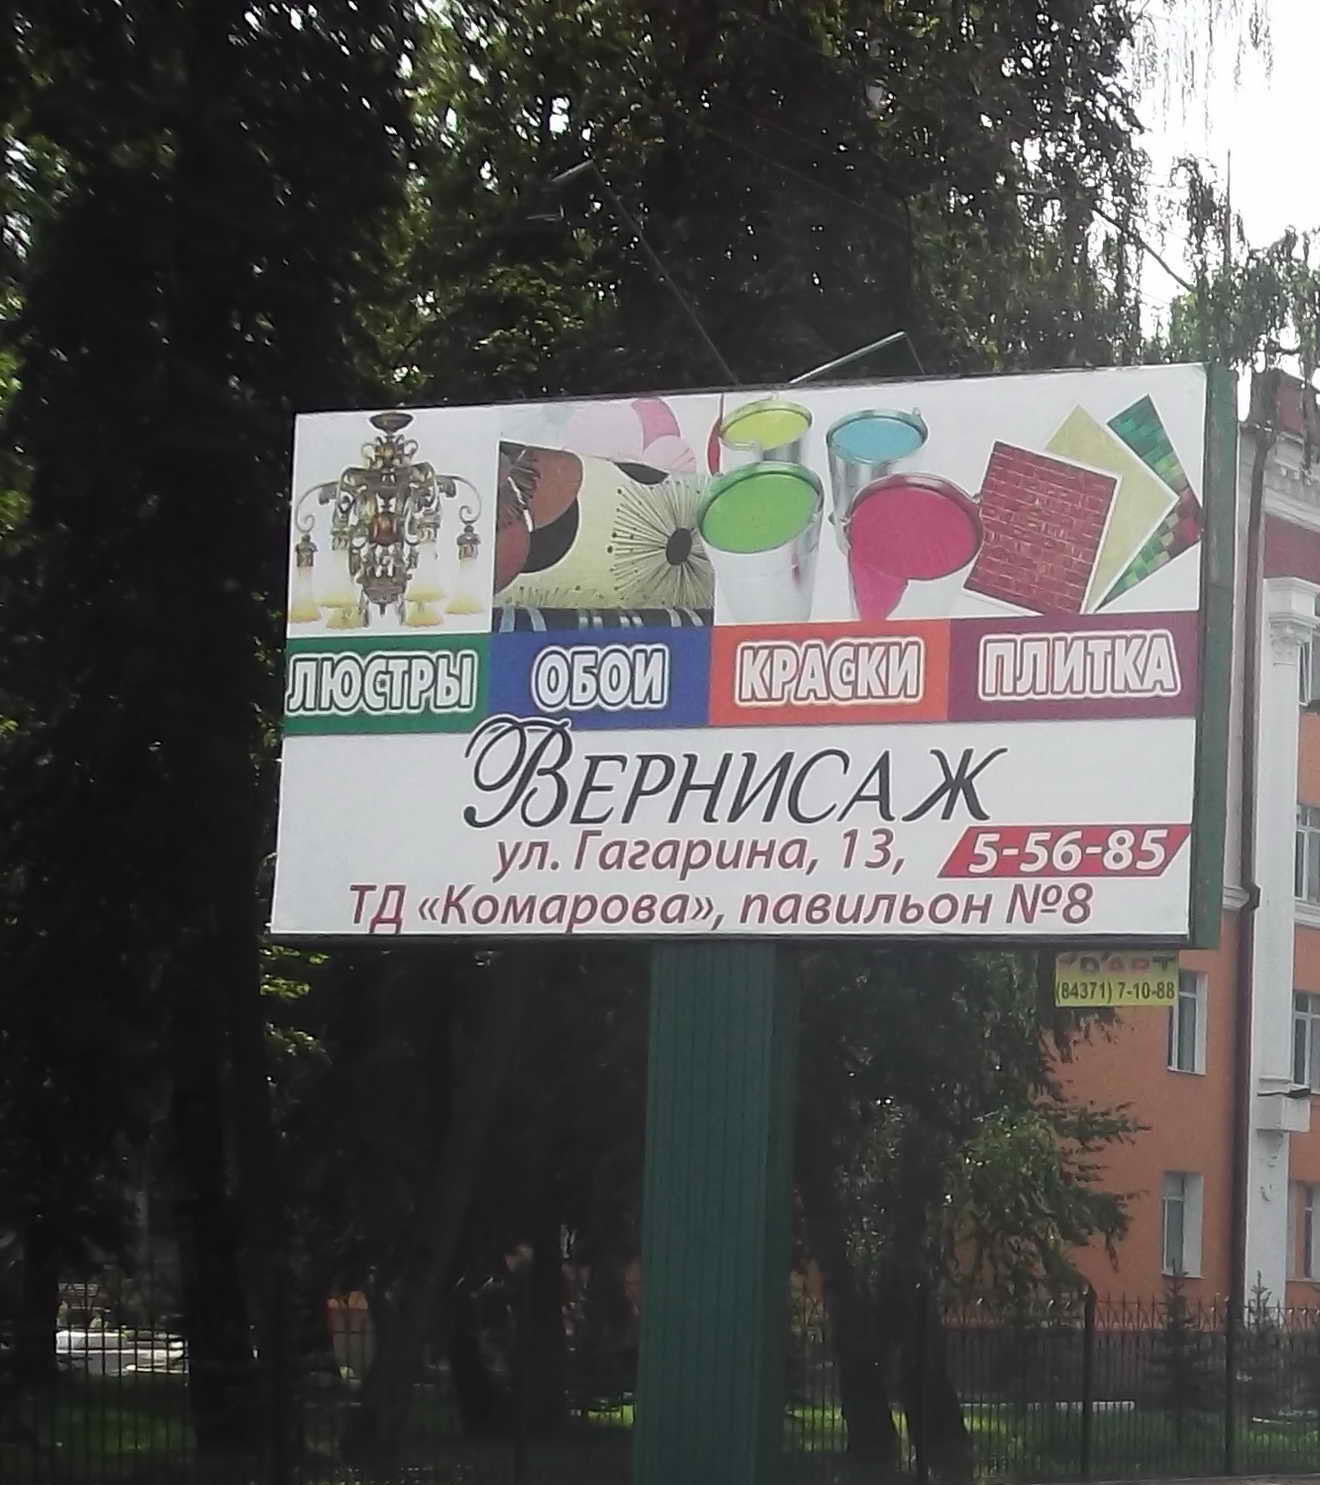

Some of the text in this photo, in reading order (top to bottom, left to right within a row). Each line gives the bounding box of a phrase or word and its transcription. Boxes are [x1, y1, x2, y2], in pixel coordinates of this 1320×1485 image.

[286, 650, 480, 716] ЛЮСТРЫ
[531, 643, 671, 712] ОБОИ
[735, 637, 925, 706] КРАСКИ
[977, 629, 1182, 702] ПЛИТКА
[463, 714, 1009, 828] ВЕРНИСАЖ
[492, 827, 905, 883] ул. Гагарина, 13,
[967, 829, 1169, 874] 5-56-85
[349, 882, 1093, 935] ТД «Комарова», павильон №8
[1056, 981, 1175, 1003] (84371) 7-10-88
